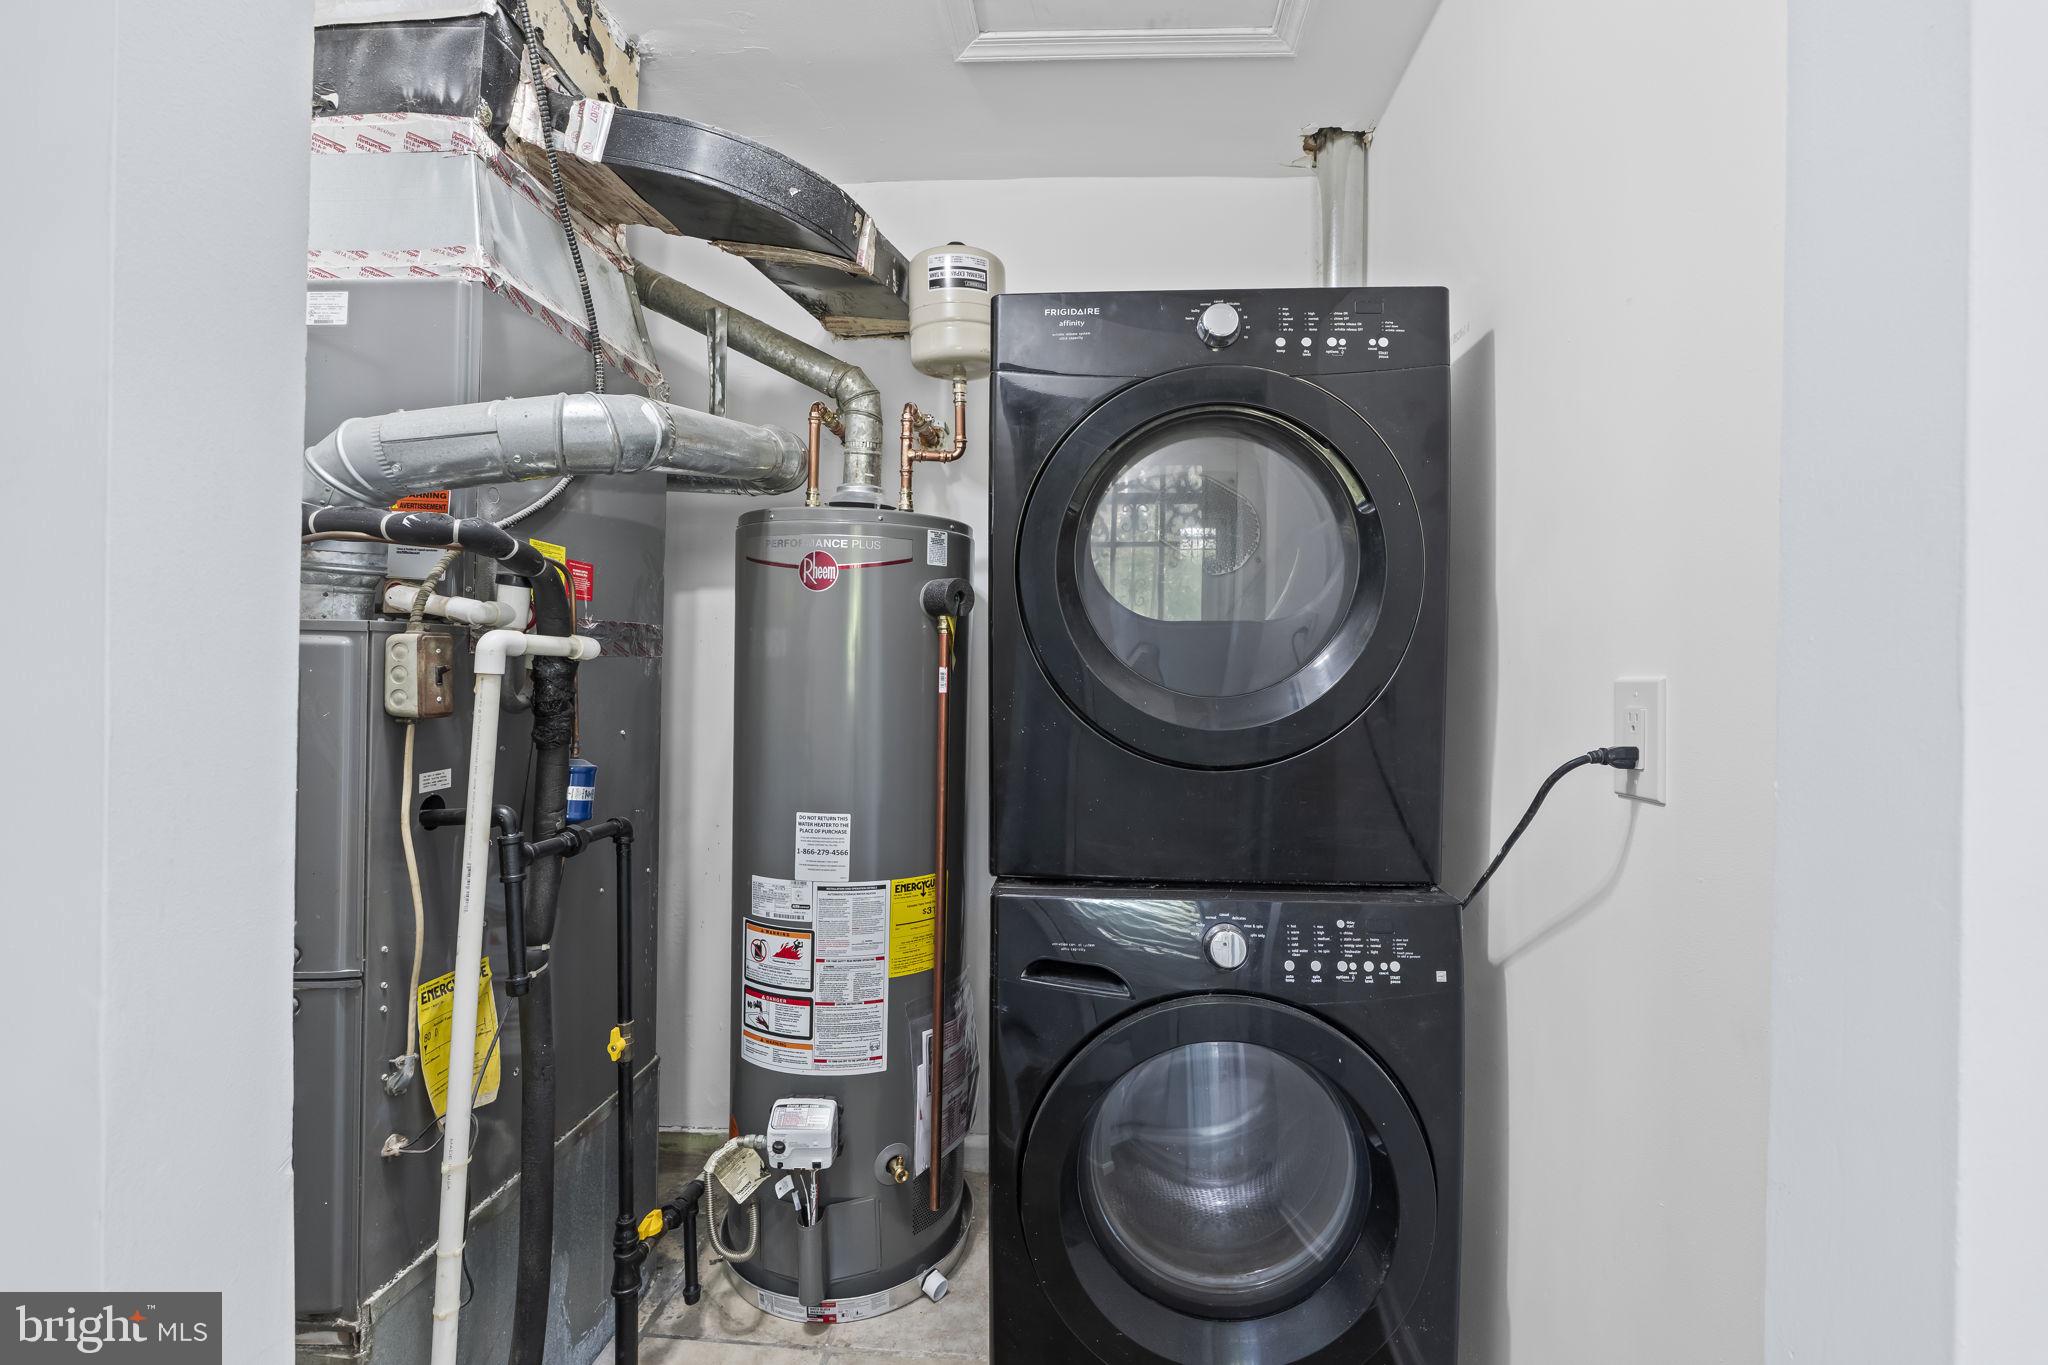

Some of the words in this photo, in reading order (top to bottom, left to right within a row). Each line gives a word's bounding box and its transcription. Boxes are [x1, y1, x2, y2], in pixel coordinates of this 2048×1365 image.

[1044, 308, 1100, 316] FRIGIDAIRE
[399, 502, 446, 510] AVERTISSEMENT
[766, 538, 848, 550] PERFOANCE
[852, 539, 881, 550] PLUS
[803, 551, 836, 585] Rheem
[895, 879, 935, 895] ENERGYGU
